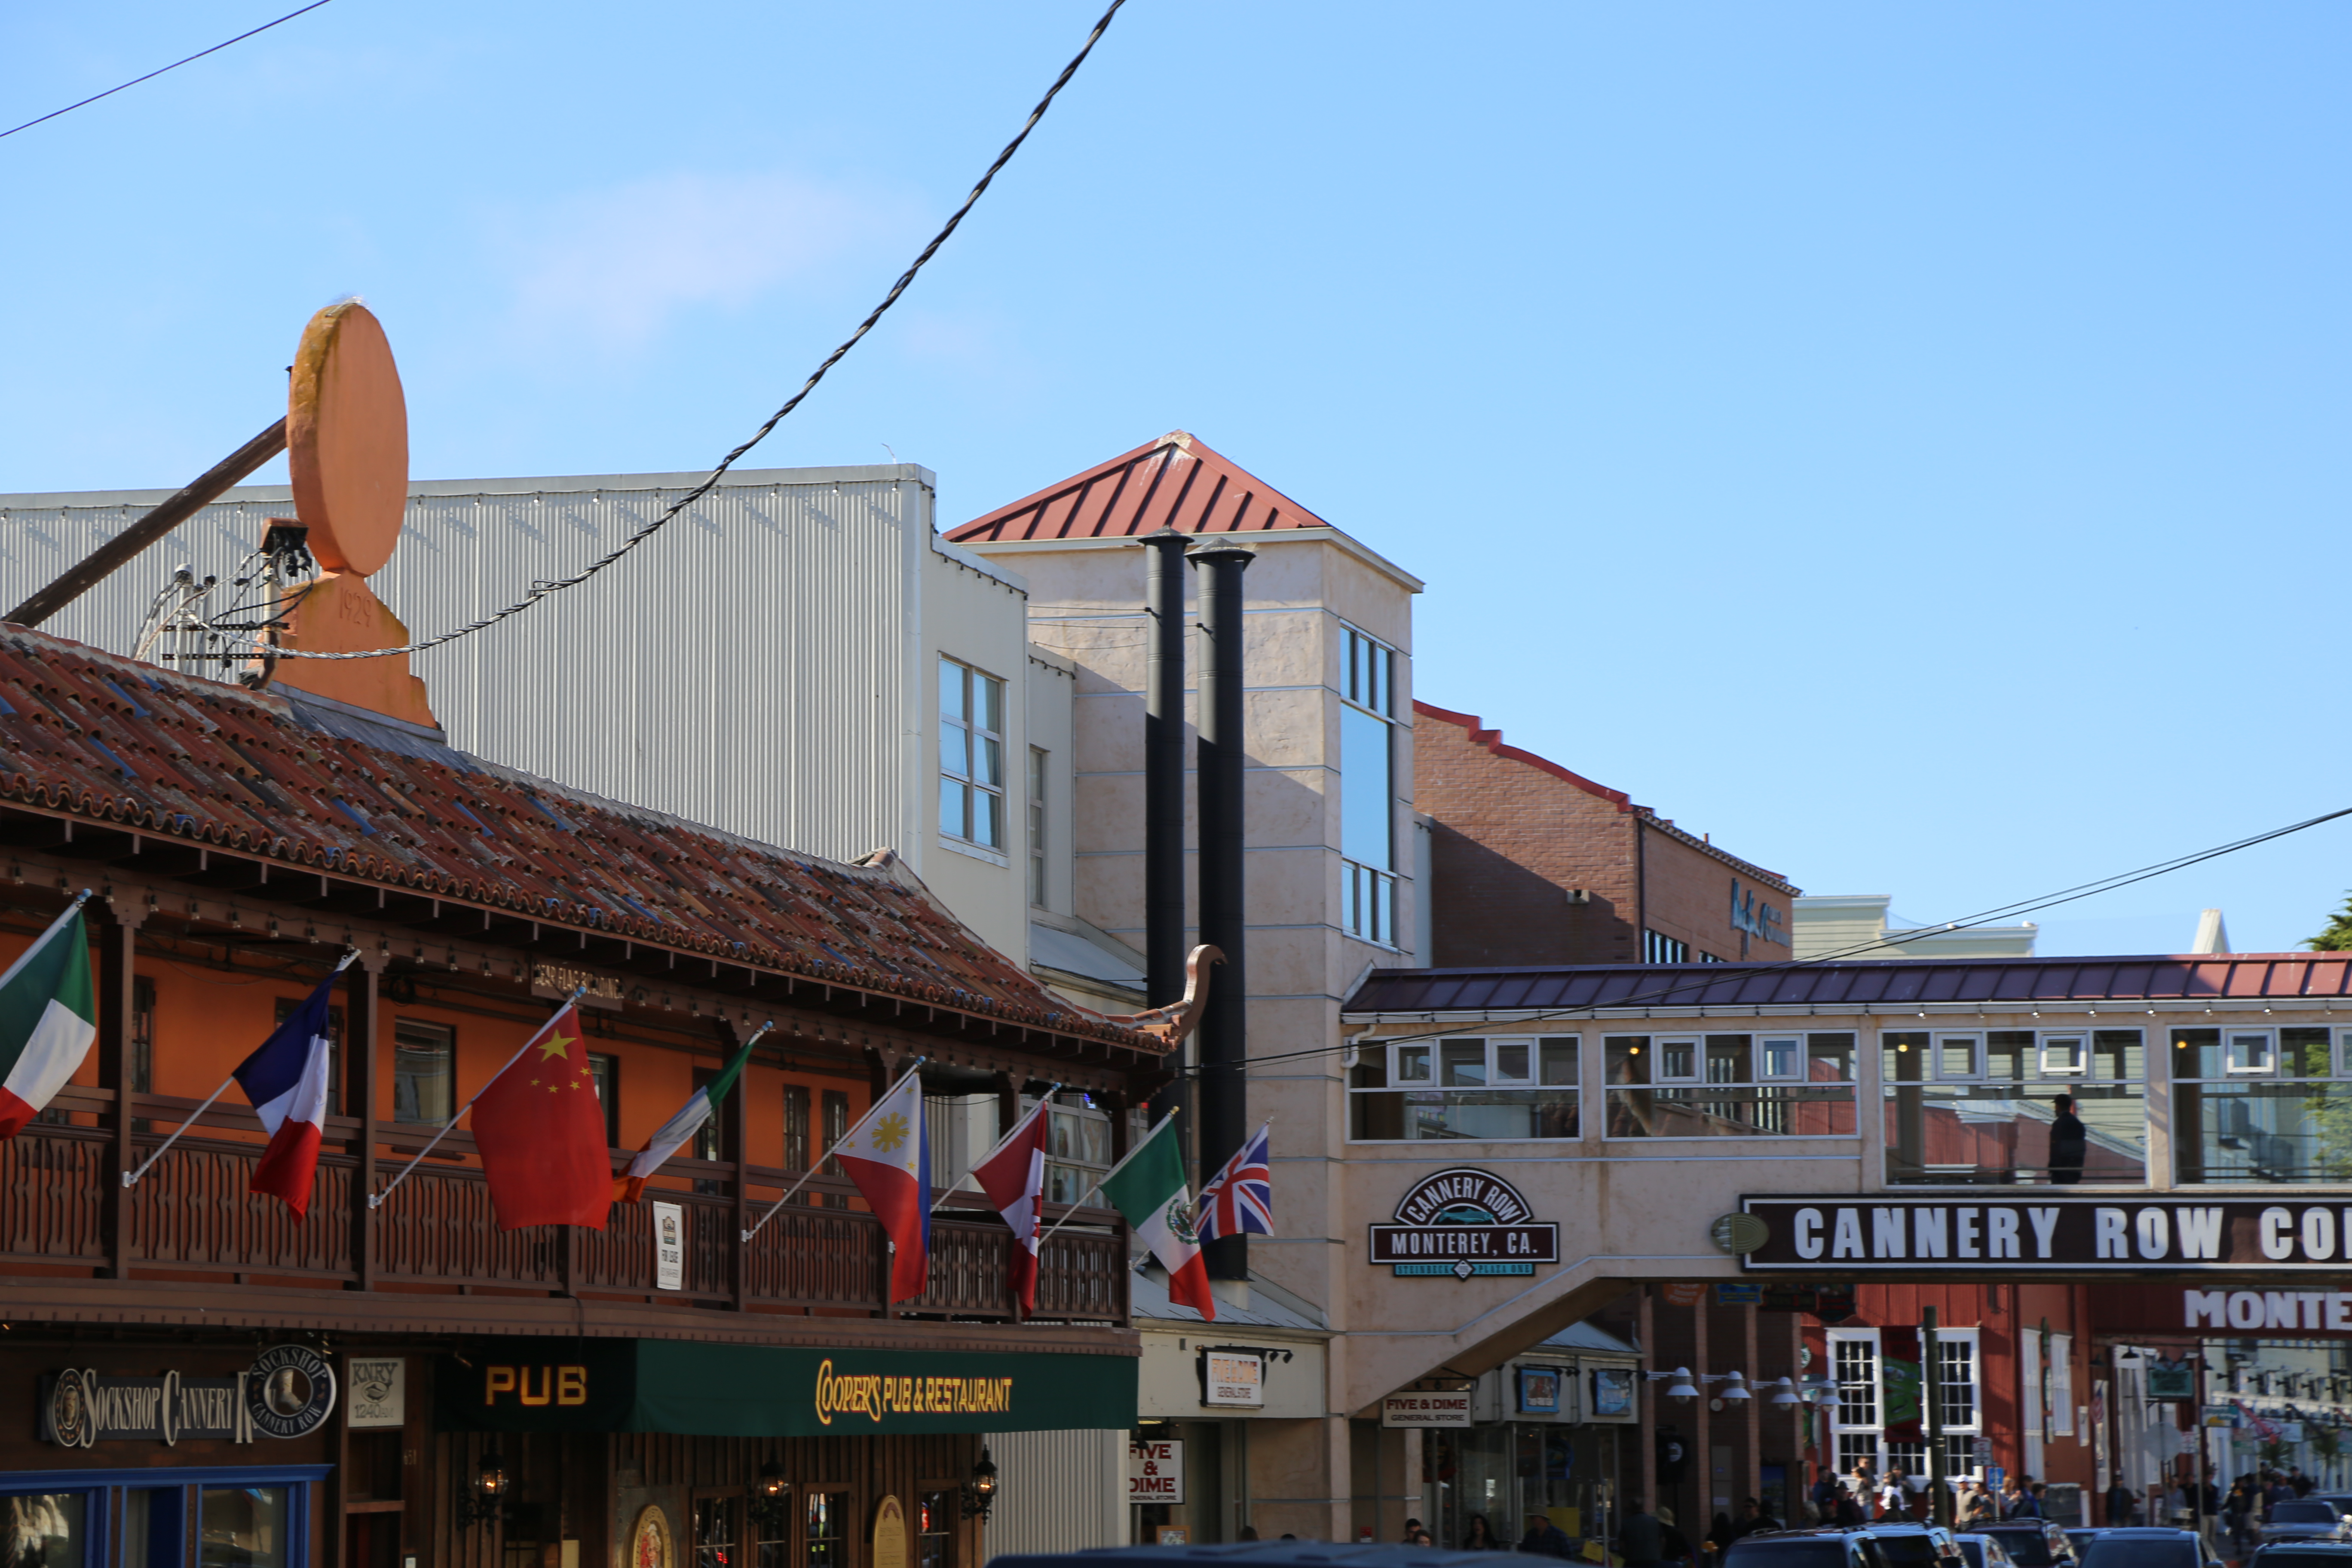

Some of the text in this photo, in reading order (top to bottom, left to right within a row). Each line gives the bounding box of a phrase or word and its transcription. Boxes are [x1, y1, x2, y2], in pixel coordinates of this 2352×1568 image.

[339, 587, 372, 628] 1929
[558, 968, 579, 992] FLAG
[1406, 1177, 1522, 1222] CANNERY ROW
[1391, 1232, 1538, 1256] MONTEREY, CA.
[1794, 1206, 2352, 1260] CANNERY ROW CO
[1398, 1265, 1450, 1274] STEINBECK
[1479, 1264, 1507, 1274] PLAZA
[1511, 1264, 1530, 1274] ONE
[2184, 1289, 2352, 1331] MONTE
[252, 1348, 328, 1380] SOCKSHOP
[352, 1362, 398, 1387] KNRY
[485, 1366, 588, 1406] PUB
[816, 1358, 1012, 1425] COOPER'S PUB & RESTAURANT
[81, 1368, 161, 1449] SOCKSHOP
[162, 1369, 235, 1447] CANNERY
[252, 1403, 323, 1433] CANNERY ROW
[1386, 1399, 1468, 1410] FIVE & DIME
[1129, 1443, 1172, 1459] FIVE
[1143, 1460, 1158, 1476] &
[1129, 1477, 1176, 1493] DIME
